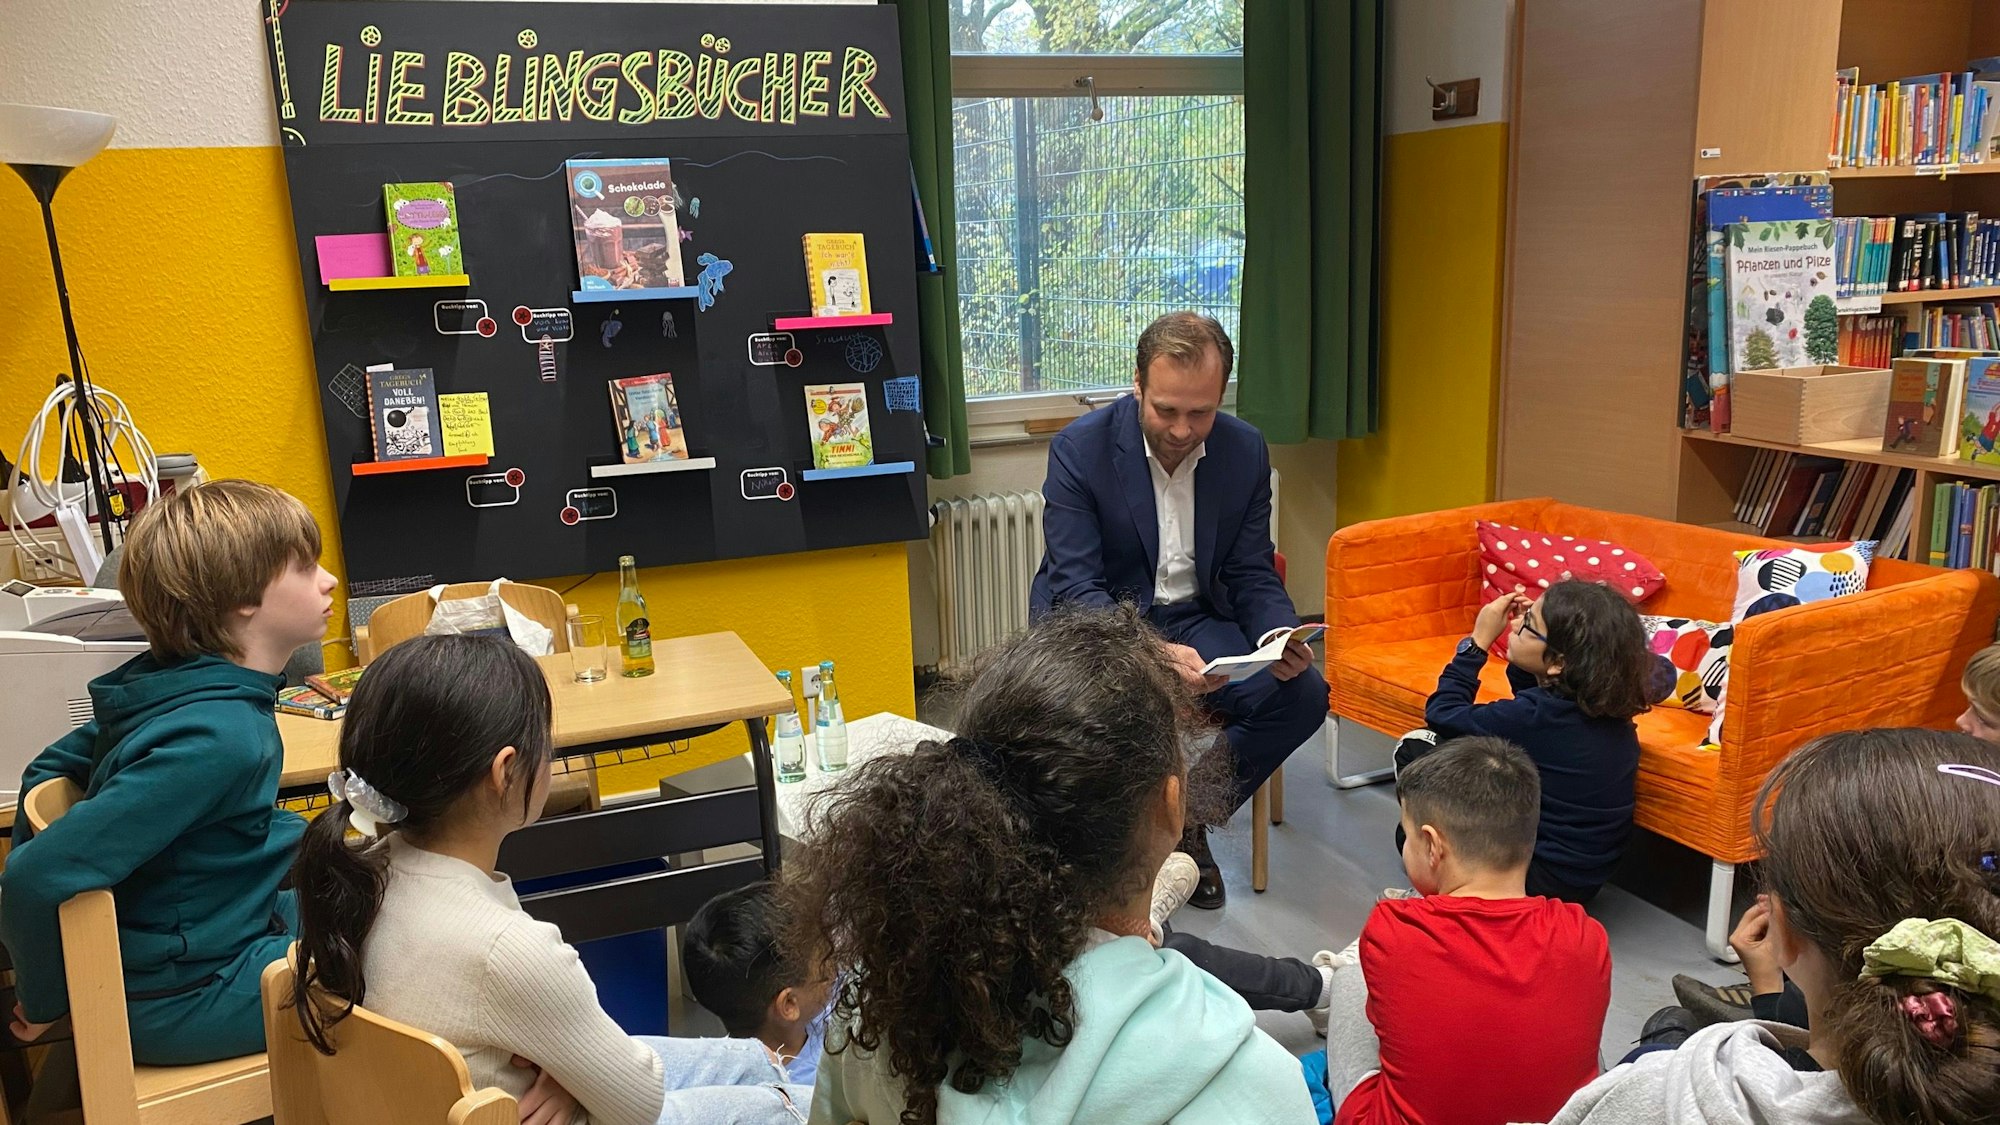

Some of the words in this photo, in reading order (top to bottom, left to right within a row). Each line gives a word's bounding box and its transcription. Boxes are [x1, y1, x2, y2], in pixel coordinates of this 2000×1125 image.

[607, 181, 666, 194] Schokolade
[1747, 245, 1763, 254] Mein
[1764, 242, 1818, 254] Riesen-Pappebuch
[1736, 258, 1781, 274] Pflanzen
[1783, 256, 1803, 271] und
[1806, 255, 1832, 271] Pilze
[379, 379, 422, 388] TAGEBUCH
[392, 387, 414, 397] VOLL
[384, 396, 426, 407] DANEBEN!
